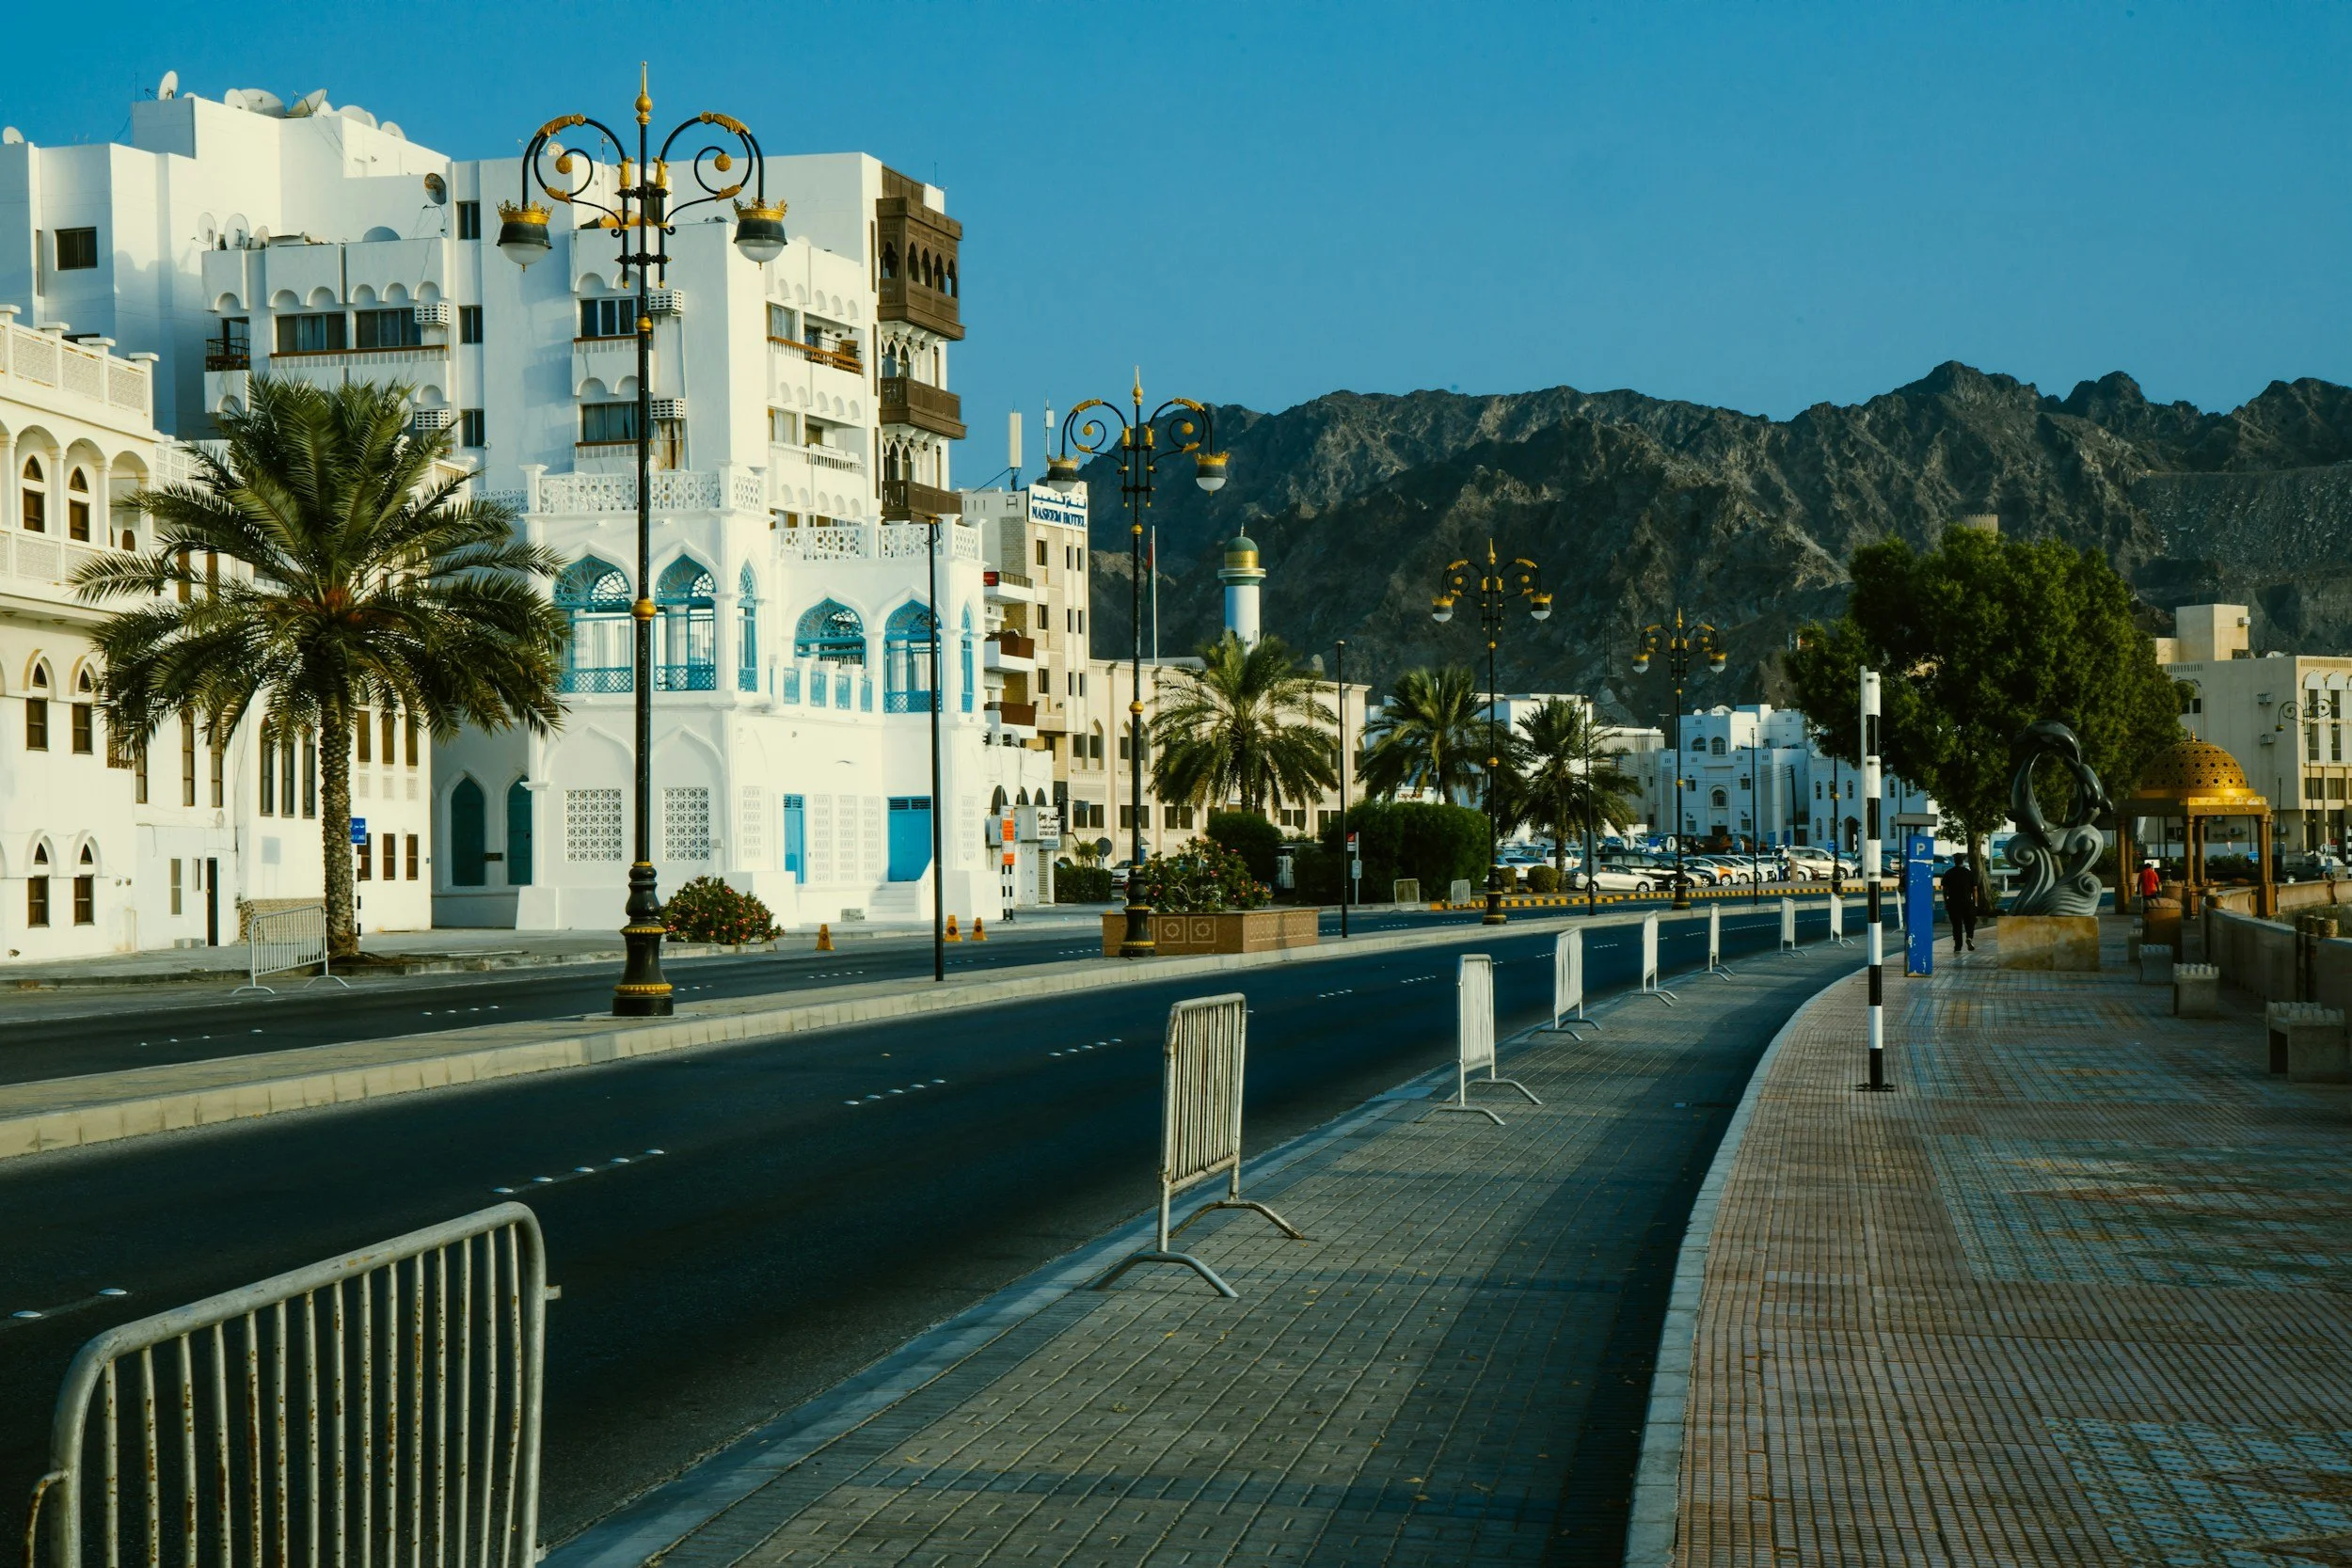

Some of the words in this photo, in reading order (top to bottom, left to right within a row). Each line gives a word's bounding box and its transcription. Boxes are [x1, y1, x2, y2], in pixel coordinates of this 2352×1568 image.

[1032, 506, 1061, 523] NASEEM
[1063, 512, 1086, 528] HOTEL
[1916, 843, 1926, 855] P
